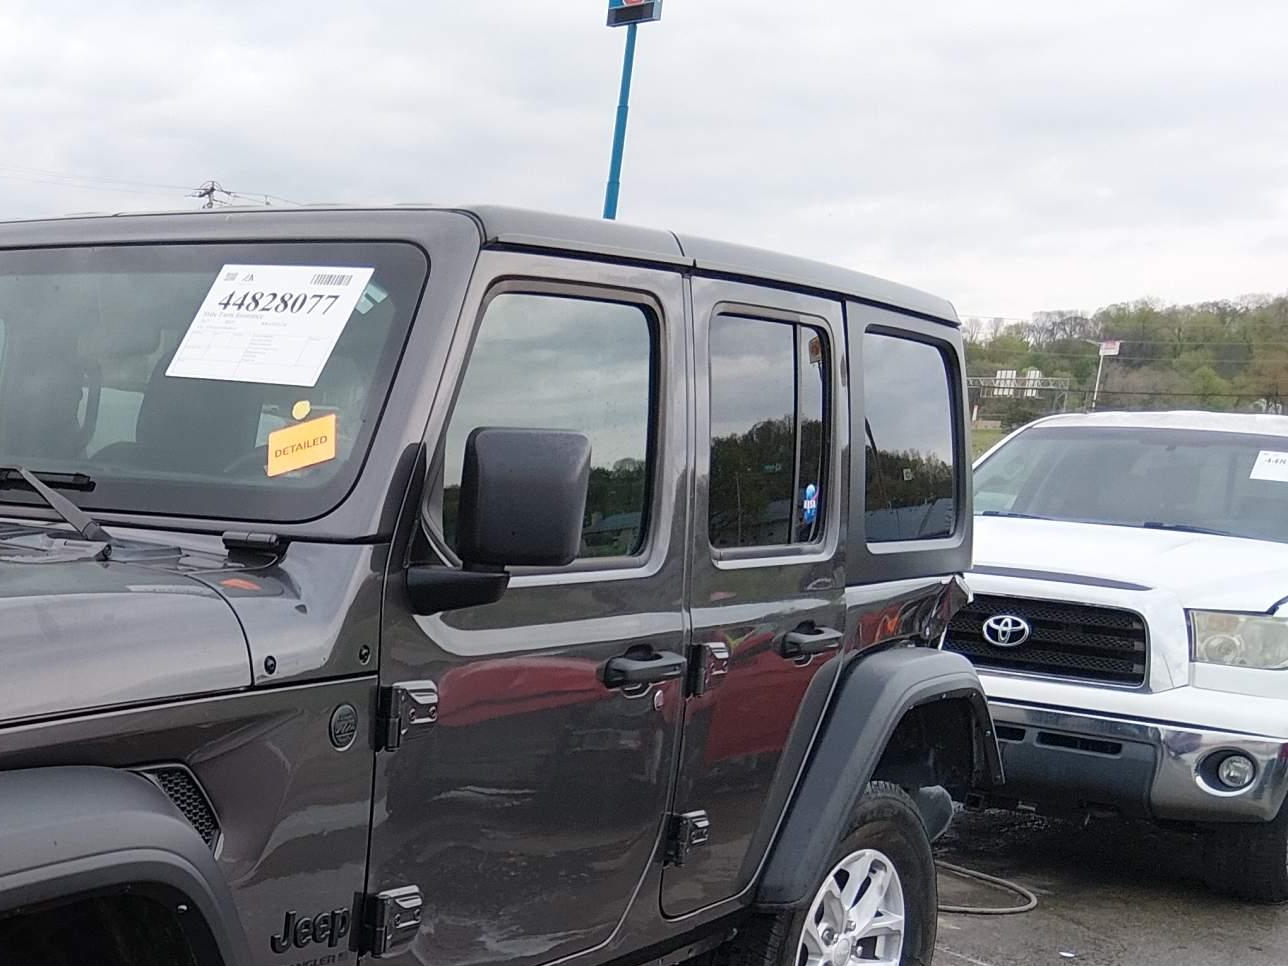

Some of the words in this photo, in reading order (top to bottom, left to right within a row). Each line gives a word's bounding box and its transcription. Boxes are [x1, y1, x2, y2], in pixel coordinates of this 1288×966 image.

[217, 290, 340, 316] 44828077
[274, 434, 328, 458] DETAILED
[269, 906, 350, 954] Jeep
